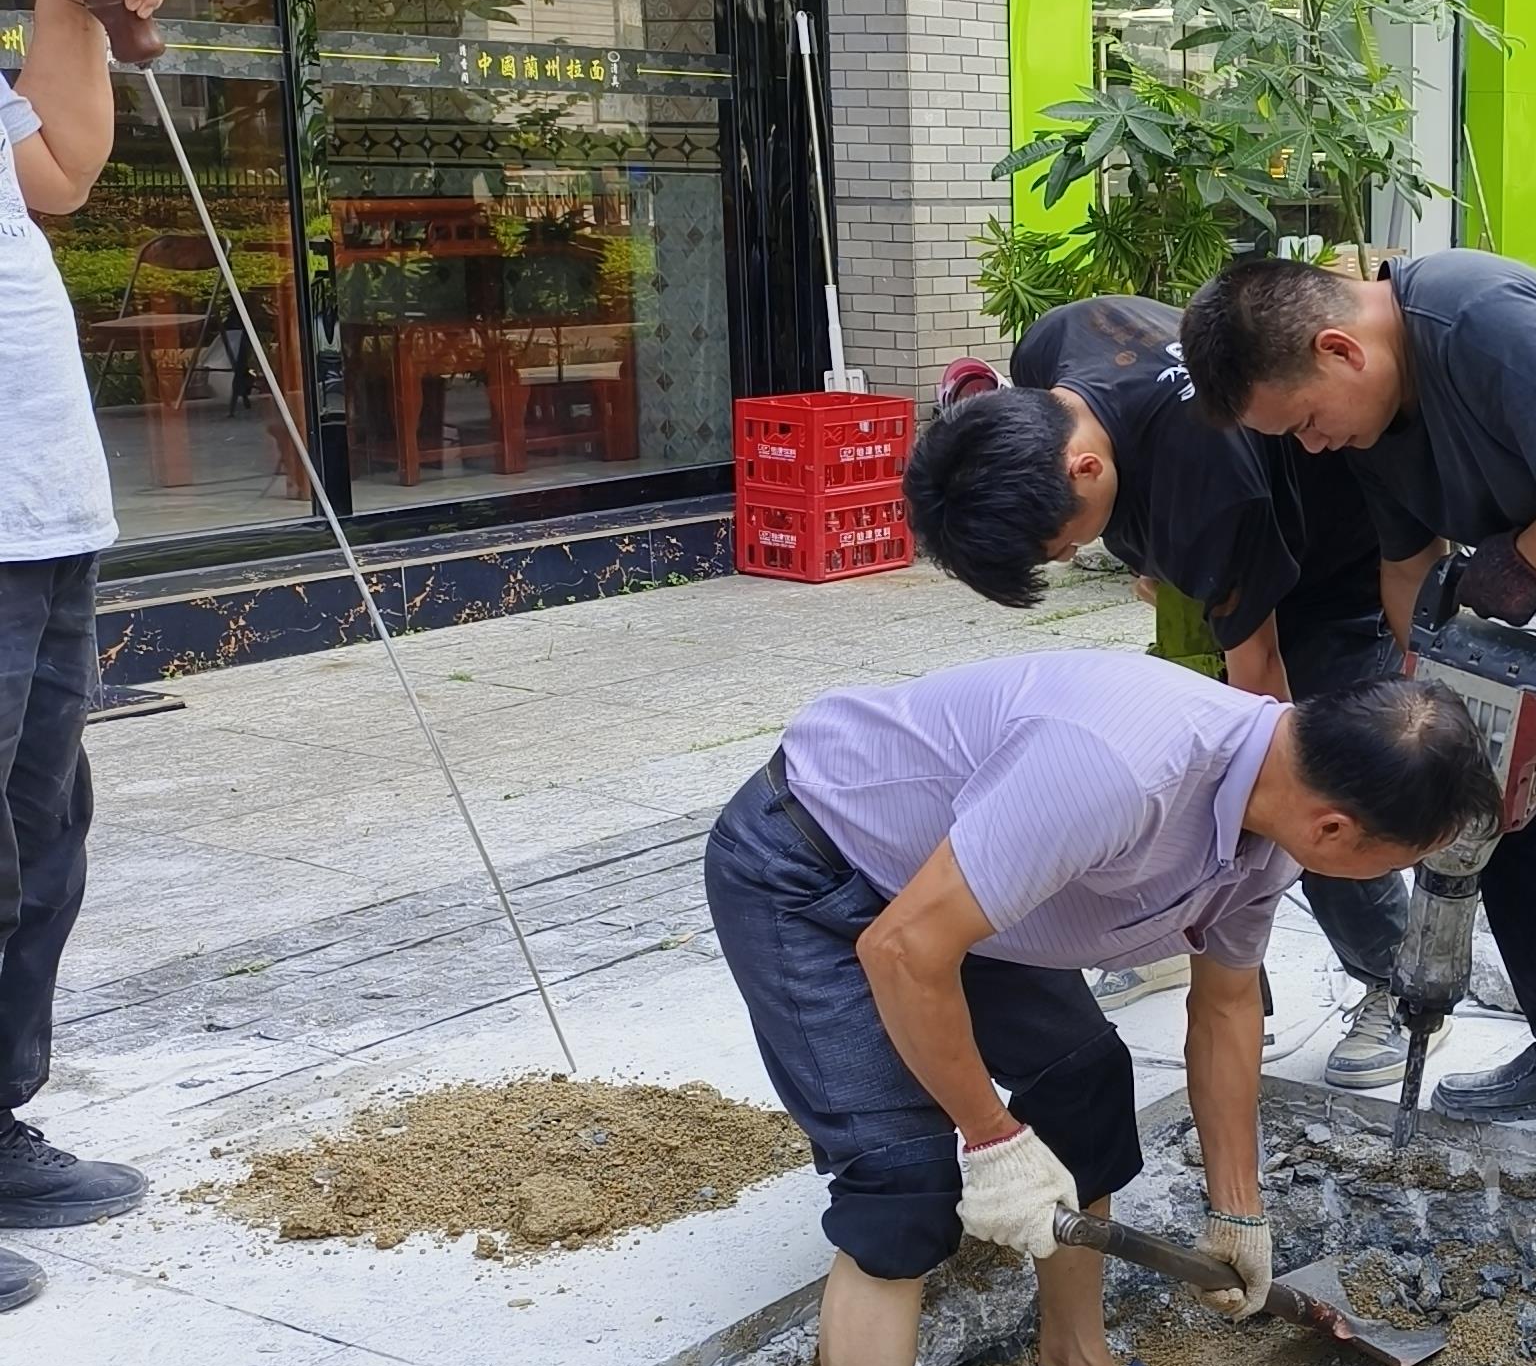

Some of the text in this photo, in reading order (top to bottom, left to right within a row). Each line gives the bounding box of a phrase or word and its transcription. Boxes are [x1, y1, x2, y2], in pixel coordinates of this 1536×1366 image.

[477, 51, 605, 83] 中國蘭州拉面
